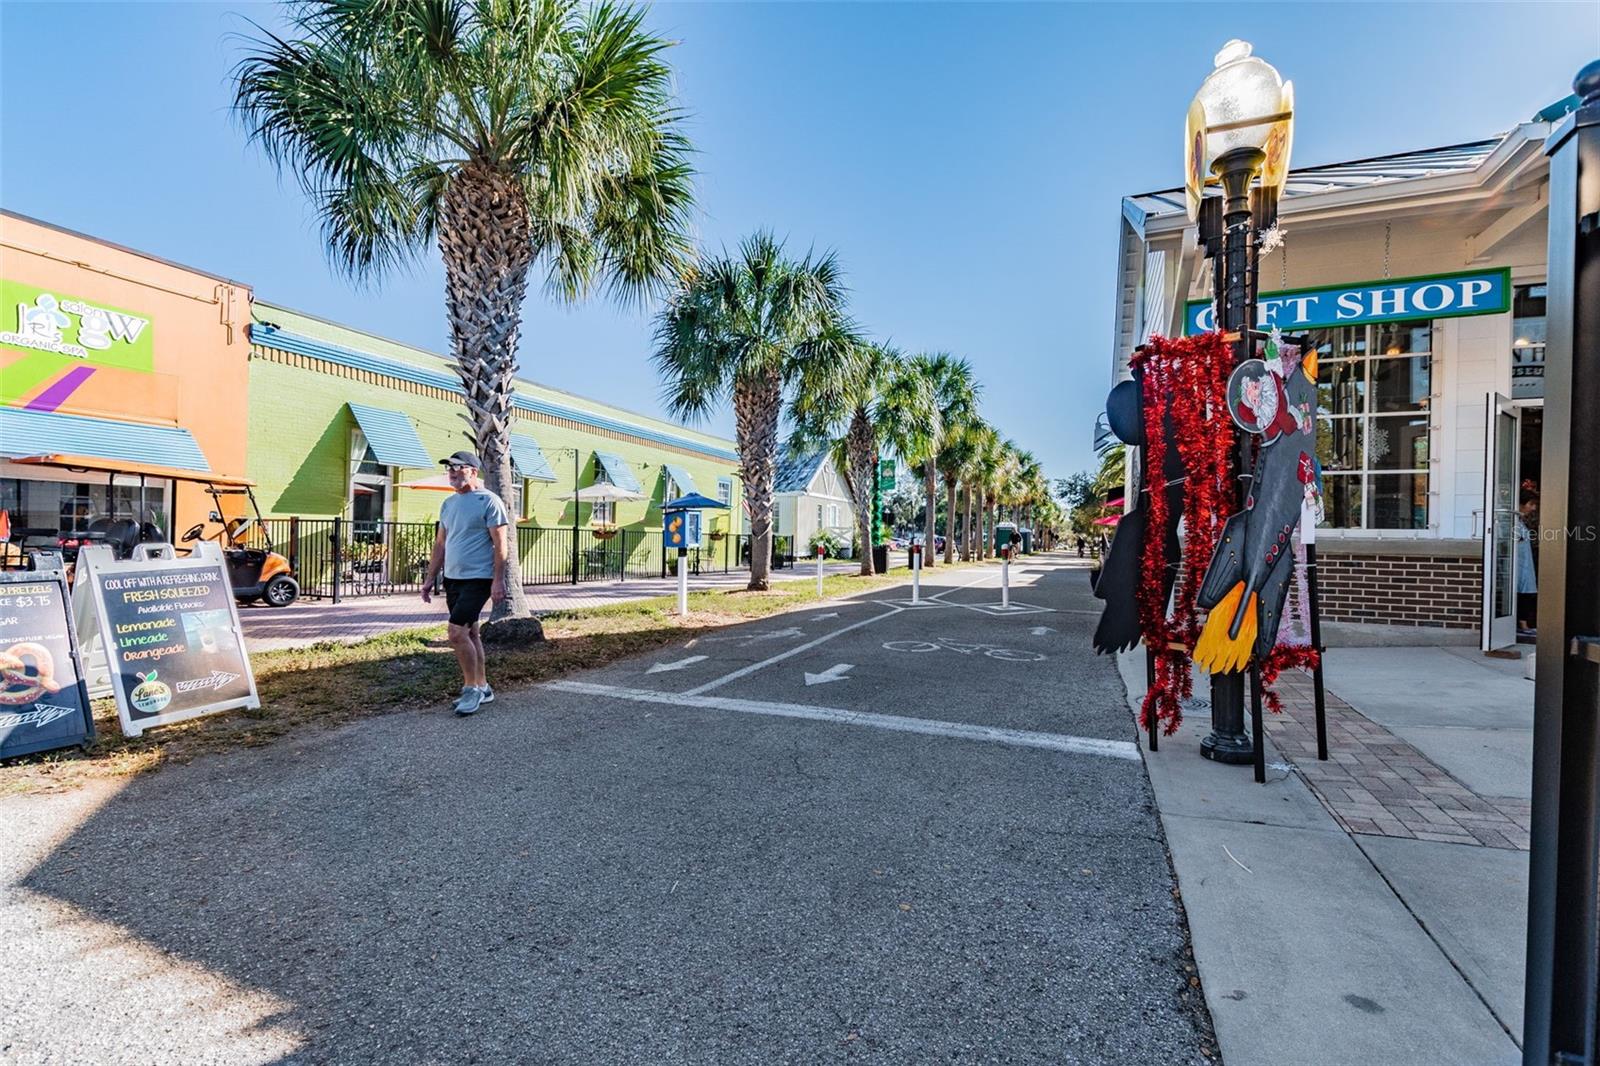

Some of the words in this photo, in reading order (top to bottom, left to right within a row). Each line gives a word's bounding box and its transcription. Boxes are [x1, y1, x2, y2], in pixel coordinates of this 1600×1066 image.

[1336, 280, 1493, 319] SHOP
[1, 333, 59, 351] ORGANIC
[62, 345, 86, 356] SPA
[105, 580, 124, 590] COOL
[124, 579, 137, 589] OFF
[137, 577, 156, 587] WITH
[156, 576, 162, 586] A
[162, 574, 201, 585] REFRESHING
[200, 572, 220, 582] DRINK
[16, 596, 51, 607] $3.75
[123, 590, 160, 603] FRESH
[160, 586, 210, 599] SQUEEZED
[137, 604, 174, 614] Available
[116, 618, 176, 633] Lemonade
[119, 633, 168, 648] Limeade
[123, 644, 186, 661] Orangeade
